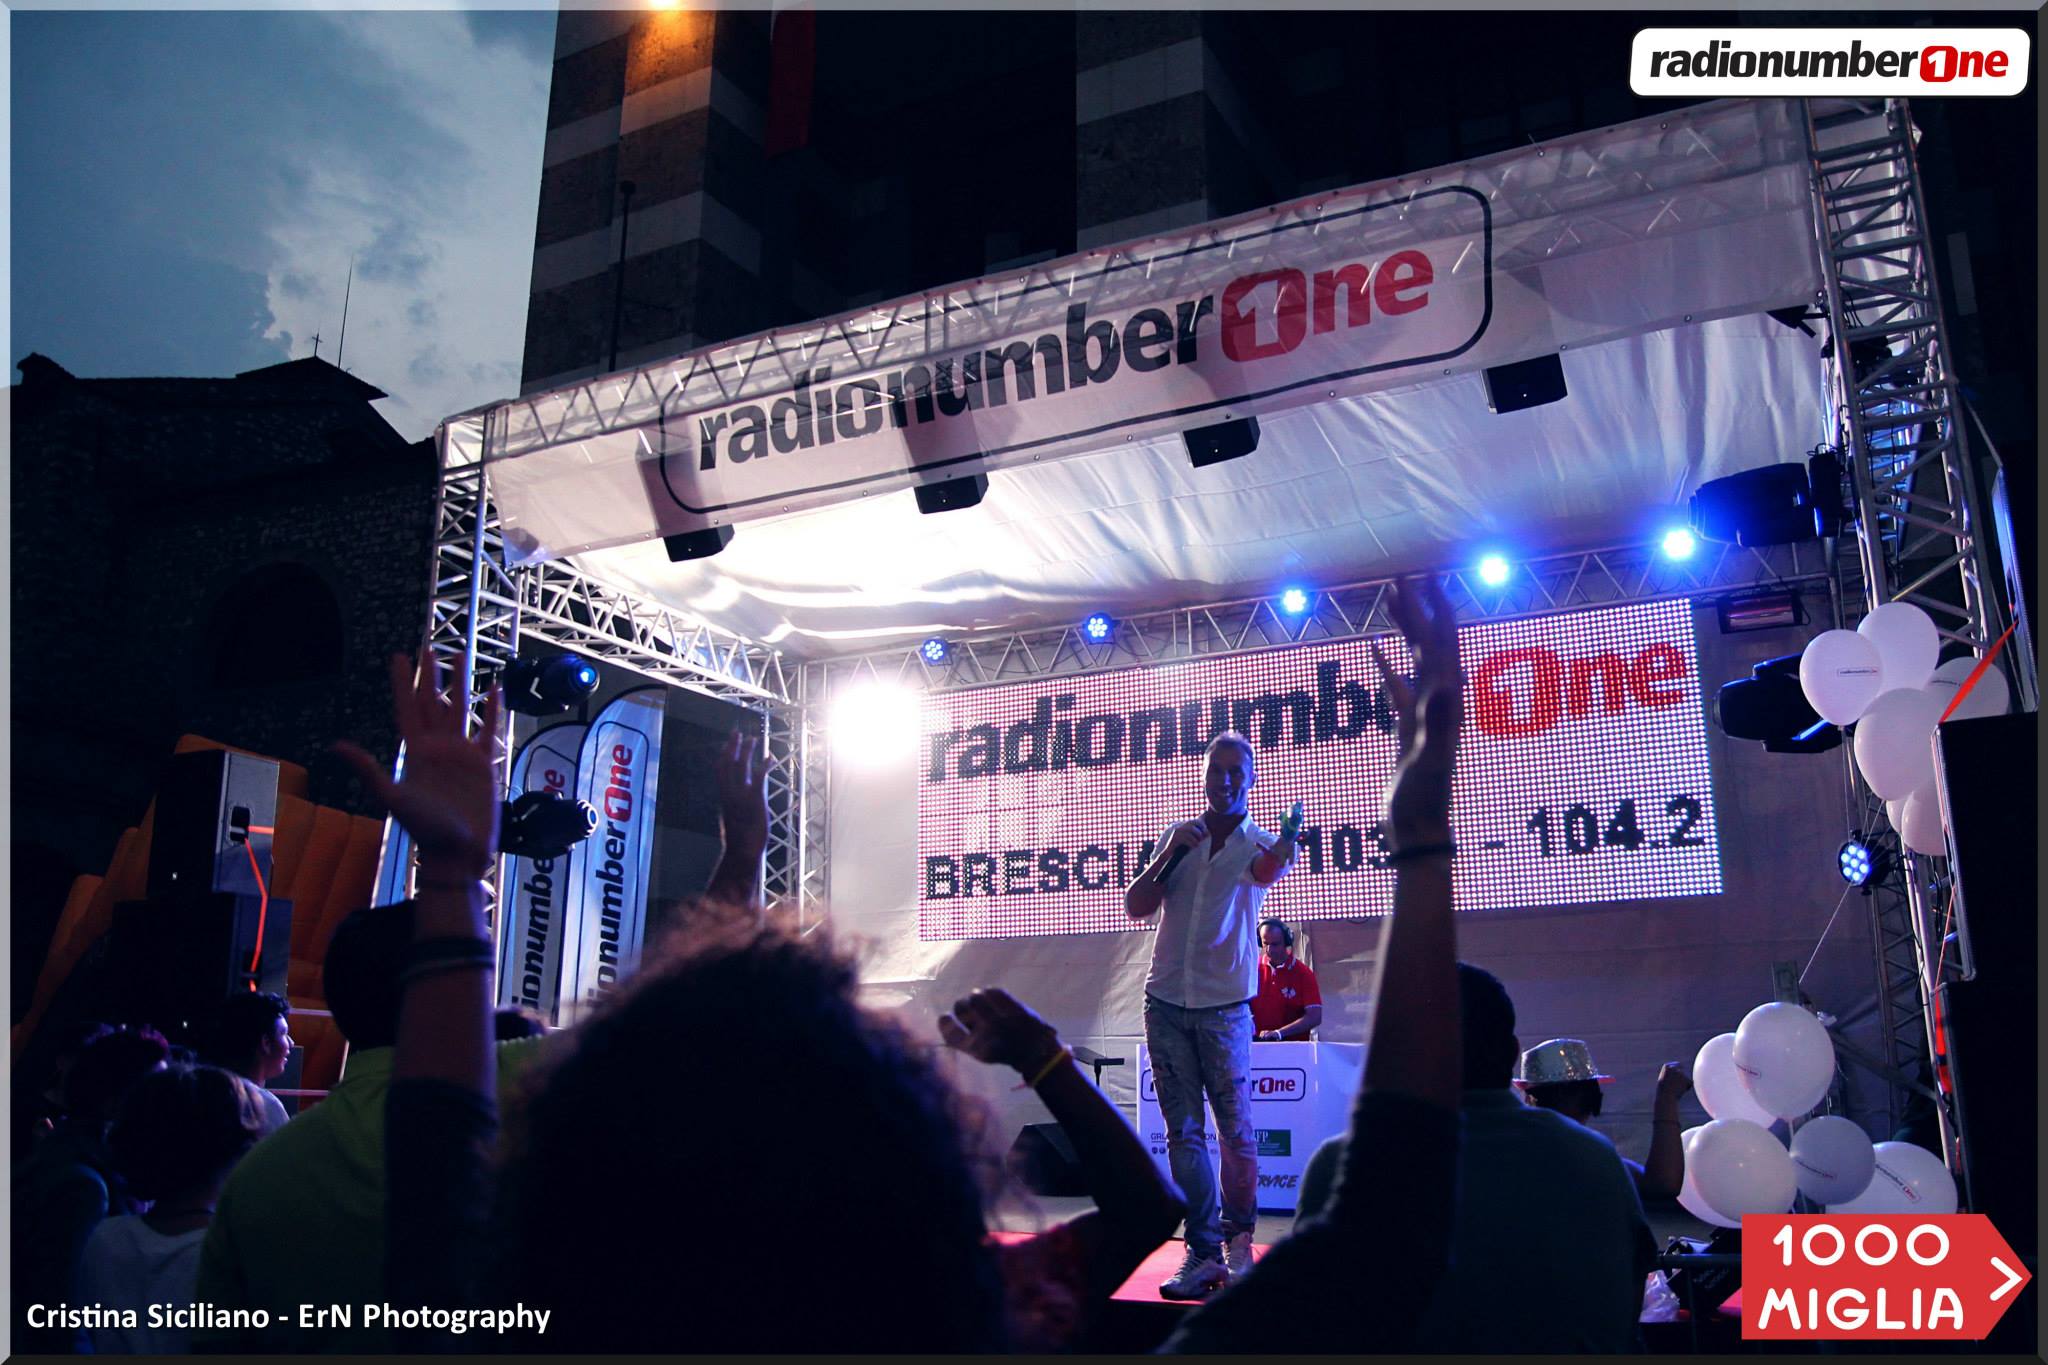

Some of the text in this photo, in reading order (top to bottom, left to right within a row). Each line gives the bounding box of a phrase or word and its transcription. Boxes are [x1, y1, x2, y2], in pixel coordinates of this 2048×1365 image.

[929, 641, 1688, 783] radionumbOne
[588, 744, 632, 1003] ionumberOne
[1527, 796, 1704, 858] 104.2
